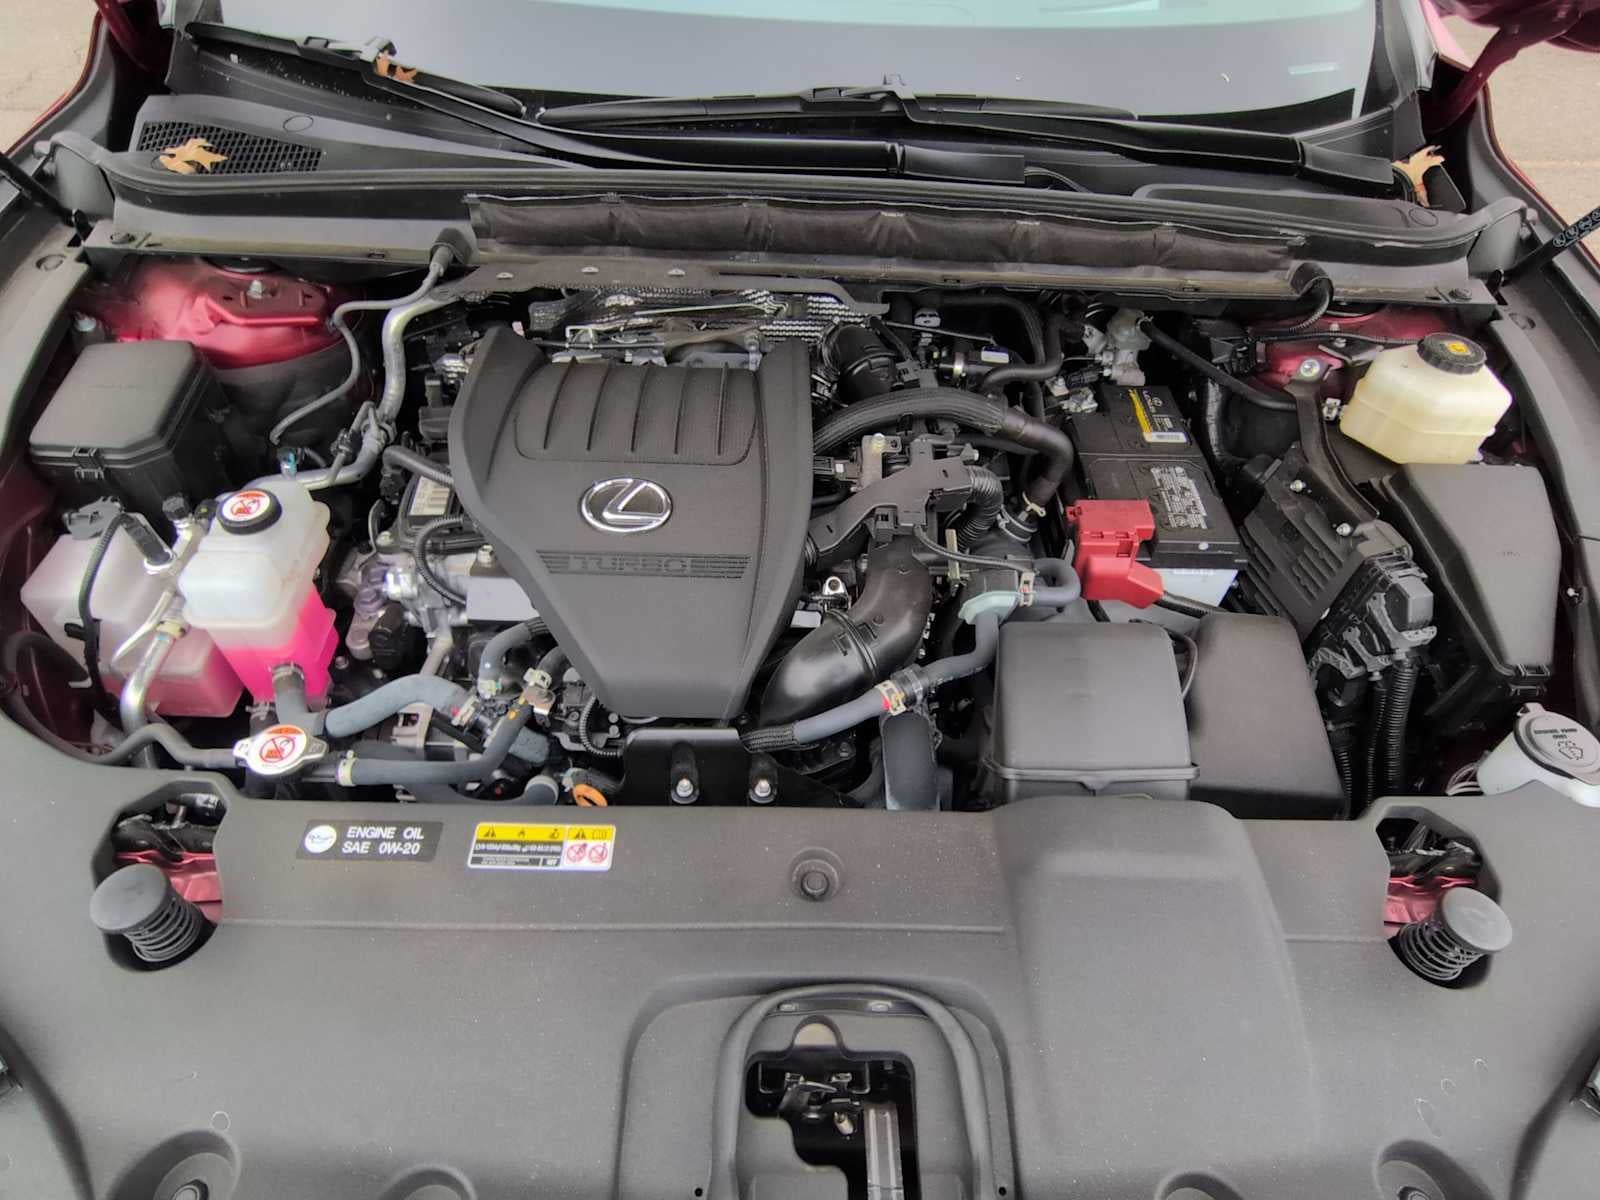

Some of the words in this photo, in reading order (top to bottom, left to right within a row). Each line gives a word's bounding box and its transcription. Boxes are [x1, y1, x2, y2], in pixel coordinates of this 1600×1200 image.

[569, 555, 688, 573] TURBO
[346, 826, 397, 839] ENGINE
[402, 827, 425, 840] OIL
[341, 841, 371, 854] SAE
[378, 842, 421, 855] 0W-20
